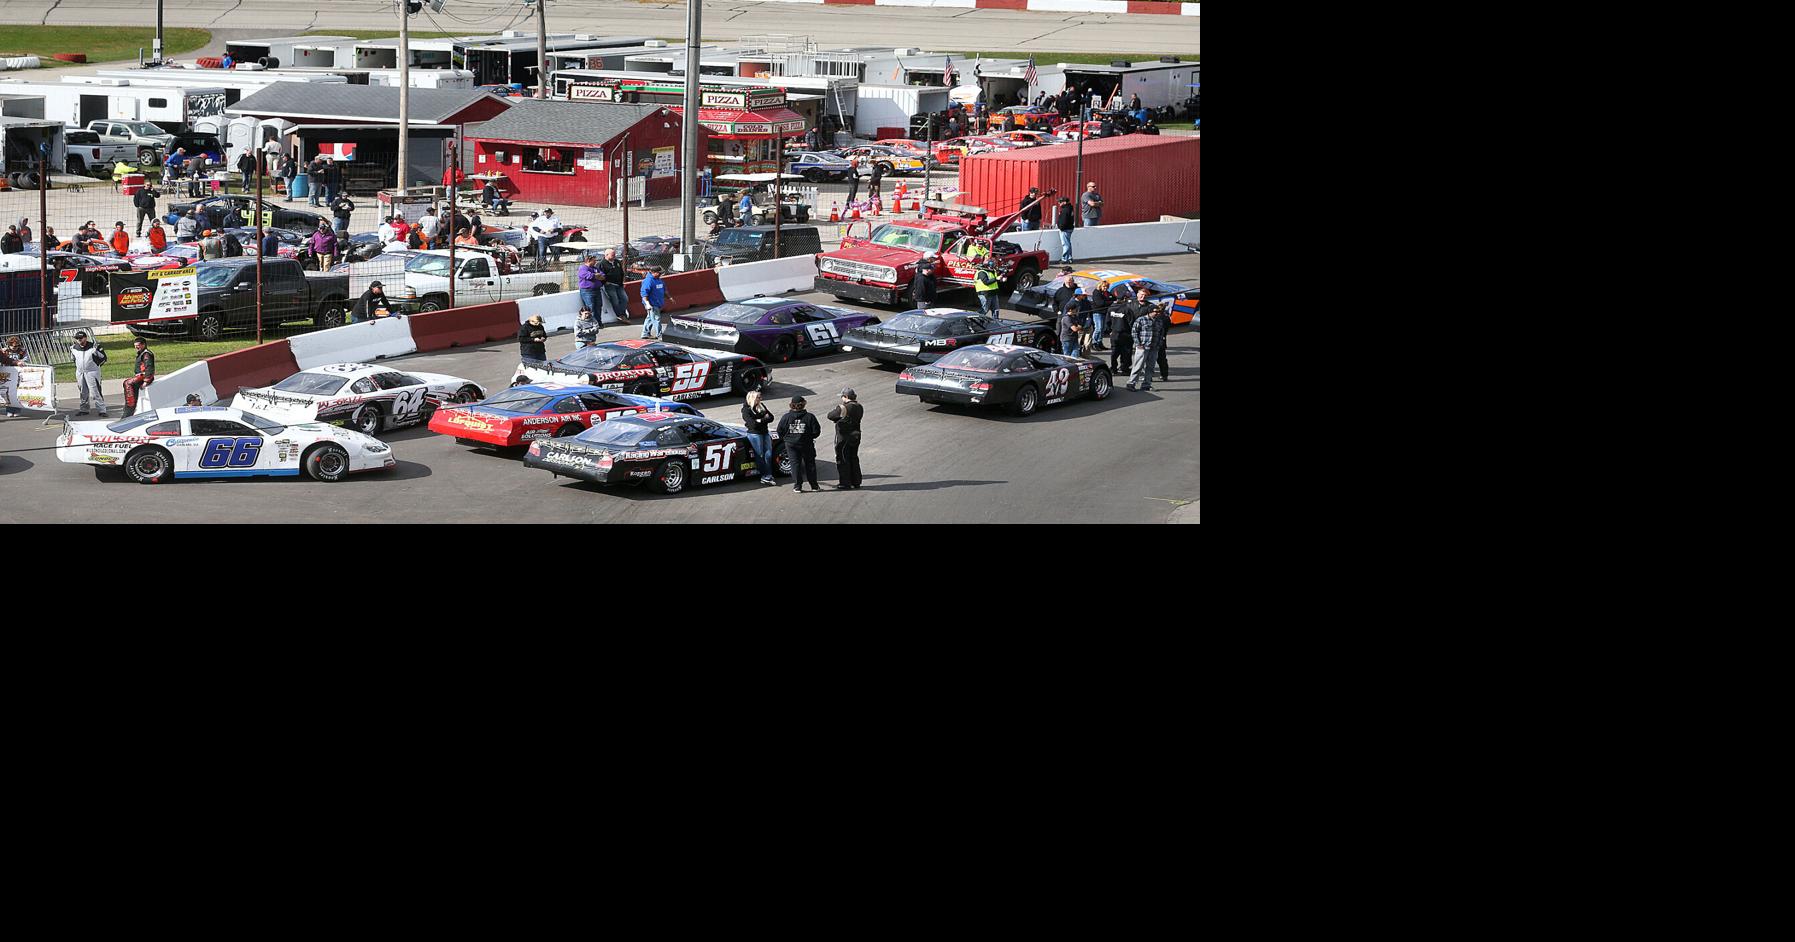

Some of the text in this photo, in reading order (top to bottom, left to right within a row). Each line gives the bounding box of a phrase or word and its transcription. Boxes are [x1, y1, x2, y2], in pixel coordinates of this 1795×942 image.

[576, 89, 607, 98] PIZZA
[707, 95, 740, 105] PIZZA
[754, 97, 781, 106] PIZZA
[60, 269, 78, 282] 7
[806, 322, 841, 346] 61
[924, 338, 957, 347] MBR
[671, 362, 711, 392] 50
[672, 392, 702, 401] CARLSON
[393, 386, 428, 419] 64
[523, 416, 559, 425] ANDERSON
[91, 435, 150, 445] WILSON
[199, 437, 264, 469] 66
[546, 451, 593, 465] CARLSON
[625, 451, 650, 459] Racing
[650, 449, 687, 457] Warehouse
[703, 442, 735, 473] 51
[702, 473, 735, 485] CARLSON
